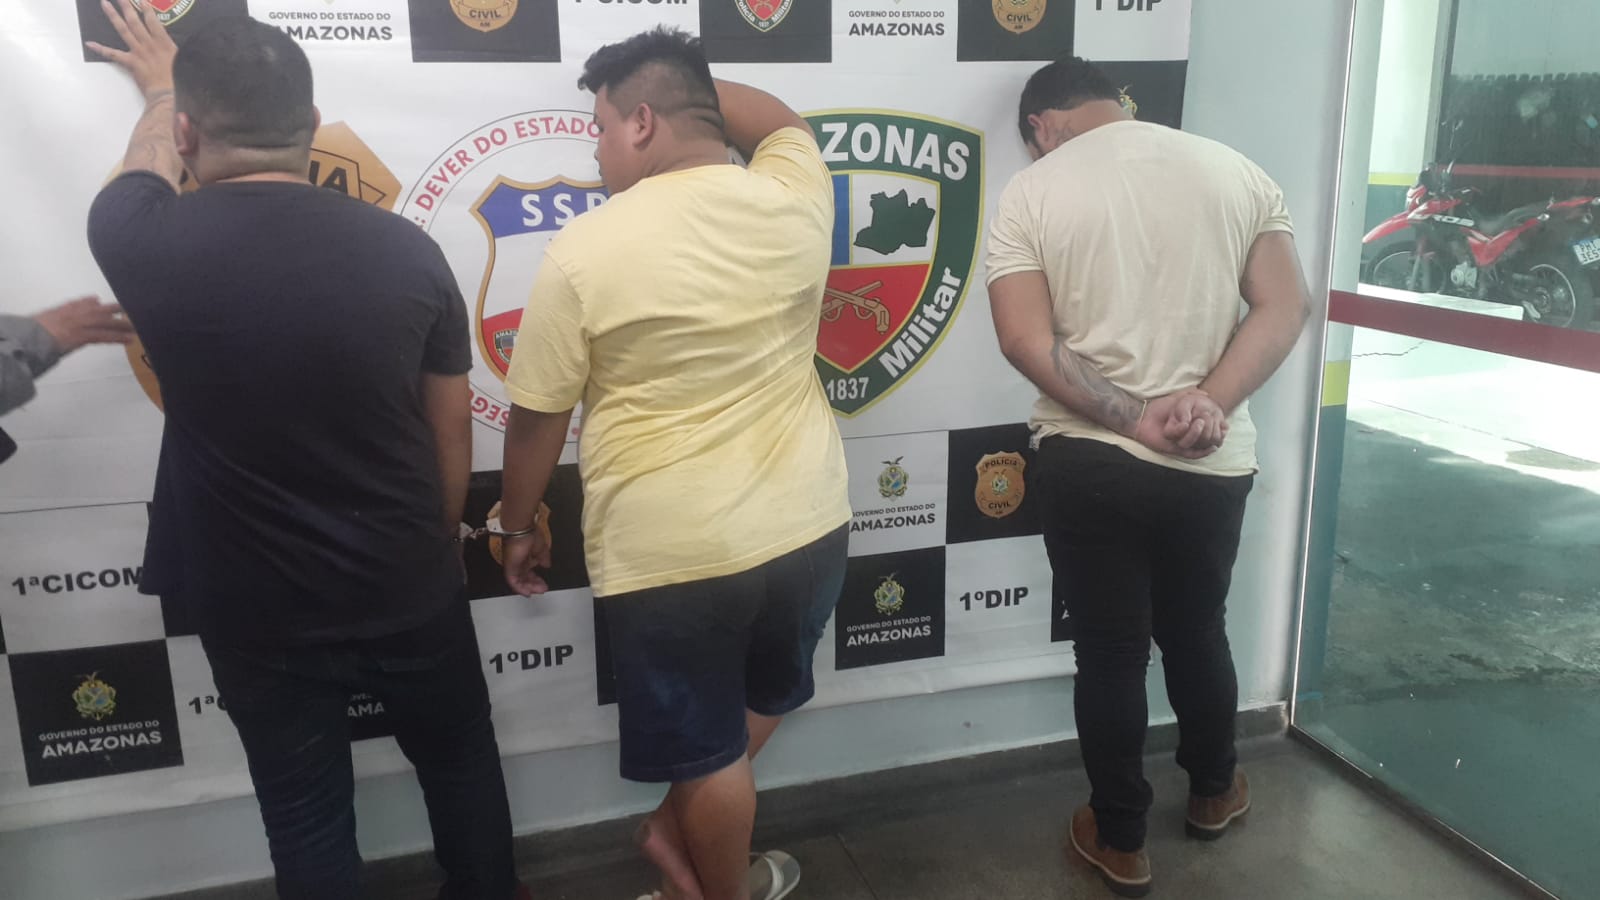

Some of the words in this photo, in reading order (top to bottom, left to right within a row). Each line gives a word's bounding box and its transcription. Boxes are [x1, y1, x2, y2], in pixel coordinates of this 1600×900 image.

[268, 11, 318, 20] GOVERNO
[320, 12, 335, 20] DO
[337, 12, 375, 20] ESTADO
[376, 12, 391, 20] DO
[469, 9, 501, 18] CIVIL
[848, 10, 887, 18] GOVERNO
[888, 10, 900, 18] DO
[902, 10, 932, 18] ESTADO
[933, 10, 945, 18] DO
[1006, 14, 1032, 22] CIVIL
[286, 25, 393, 41] MAZONAS
[848, 22, 945, 36] AMAZONAS
[821, 122, 970, 181] ZONAS
[415, 149, 473, 211] DEVER
[473, 127, 508, 156] DO
[878, 267, 962, 378] Militar
[826, 377, 869, 400] 1837
[897, 504, 924, 513] ESTADO
[988, 501, 1011, 509] CIVIL
[850, 512, 936, 533] AMAZONAS
[846, 622, 880, 633] GOVERNO
[881, 620, 892, 628] DO
[893, 616, 920, 626] ESTADO
[920, 615, 932, 623] DO
[846, 624, 932, 648] AMAZONAS
[39, 728, 88, 742] GOVERNO
[89, 726, 104, 735] DO
[106, 721, 143, 733] ESTADO
[144, 719, 160, 729] DO
[42, 730, 162, 759] AMAZONAS
